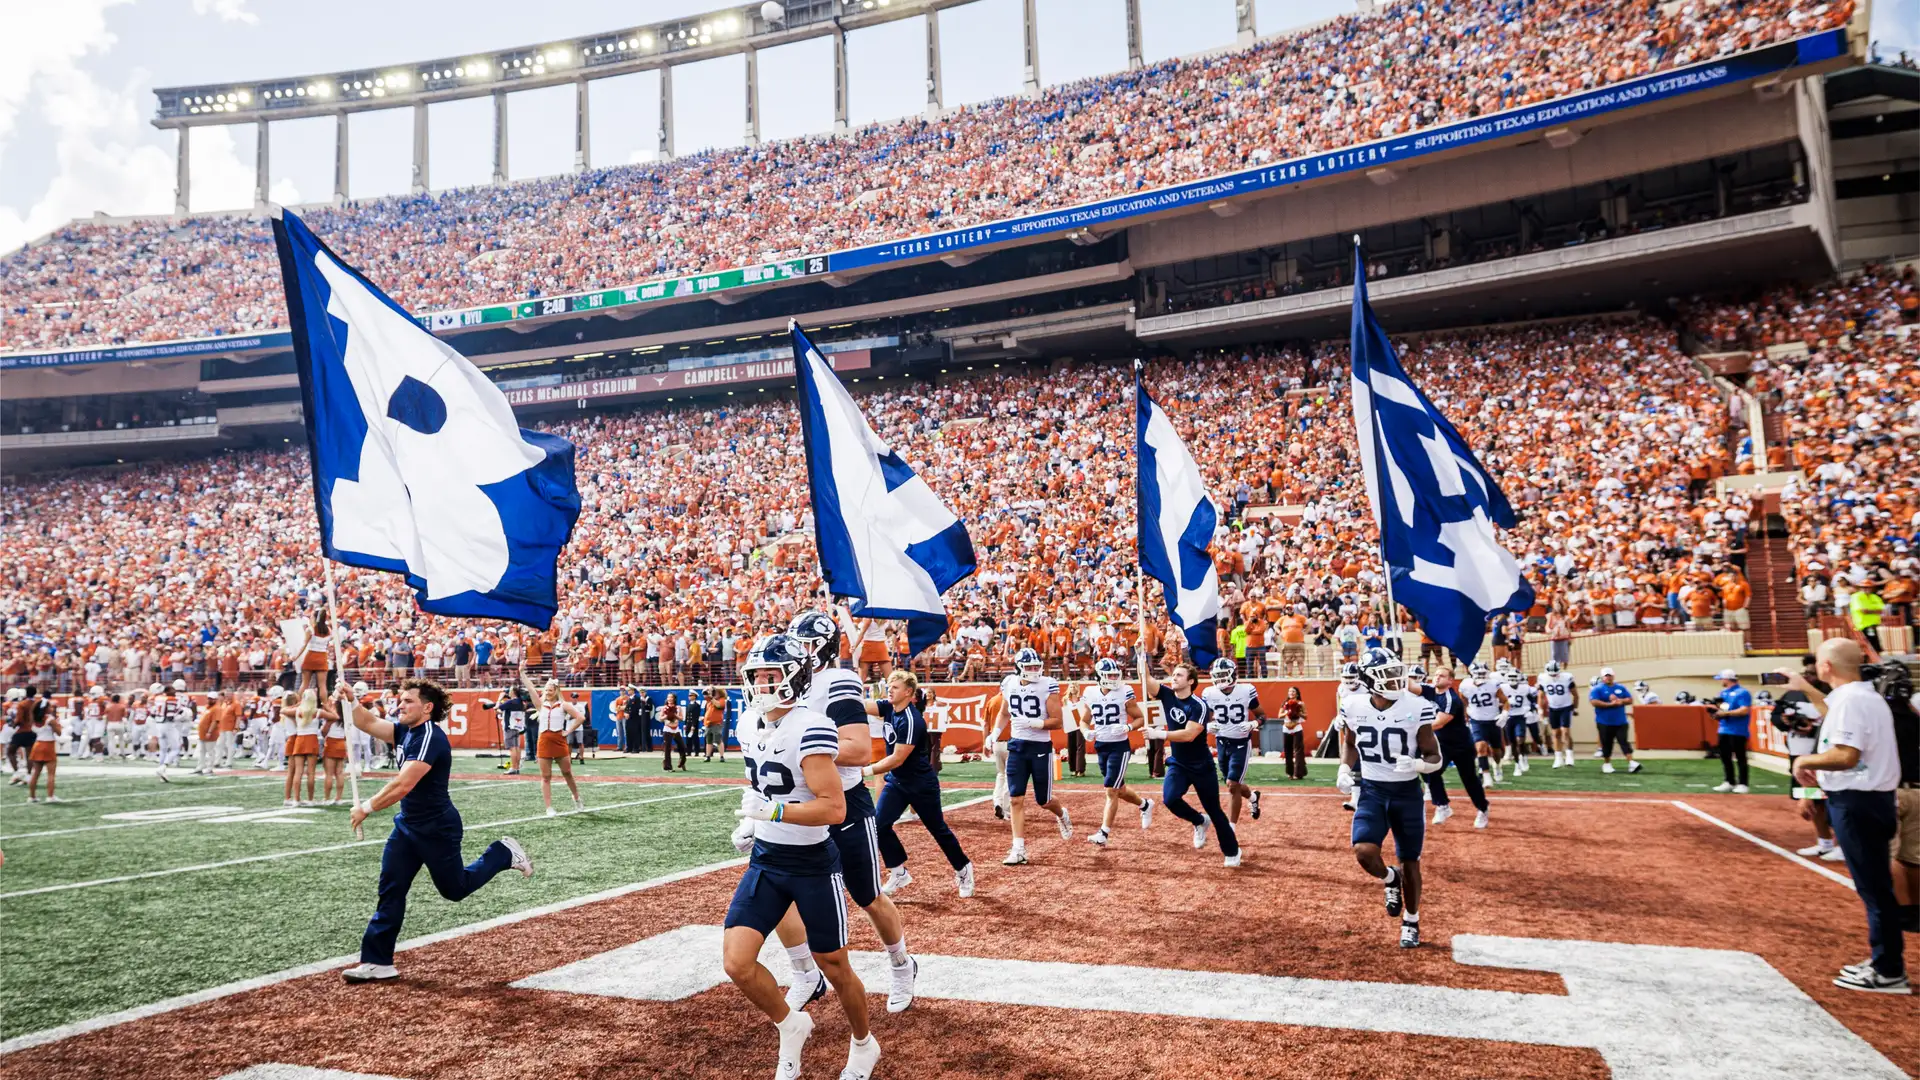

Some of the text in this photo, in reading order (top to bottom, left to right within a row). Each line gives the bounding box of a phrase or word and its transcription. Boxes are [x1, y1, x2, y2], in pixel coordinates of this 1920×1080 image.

[1260, 65, 1727, 184] TEXAS LOTTERY SUPPORTING TEXAS EDUCATION AND VETERANS
[893, 180, 1235, 257] TEXAS LOTTERY SUPPORTING TEXAS EDUCATION AND VETERANS
[809, 257, 824, 273] 25
[542, 298, 566, 315] 2:40
[589, 293, 603, 307] 1ST
[465, 311, 482, 325] BYU
[505, 360, 797, 404] TEXAS MEMORIAL STADIUM CAMPBELL WILLIAM
[1009, 694, 1041, 718] 93
[1470, 692, 1493, 708] 42
[924, 711, 939, 730] H
[1091, 703, 1120, 726] 22
[1147, 706, 1160, 724] F
[1214, 704, 1246, 724] 33
[1356, 725, 1409, 764] 20
